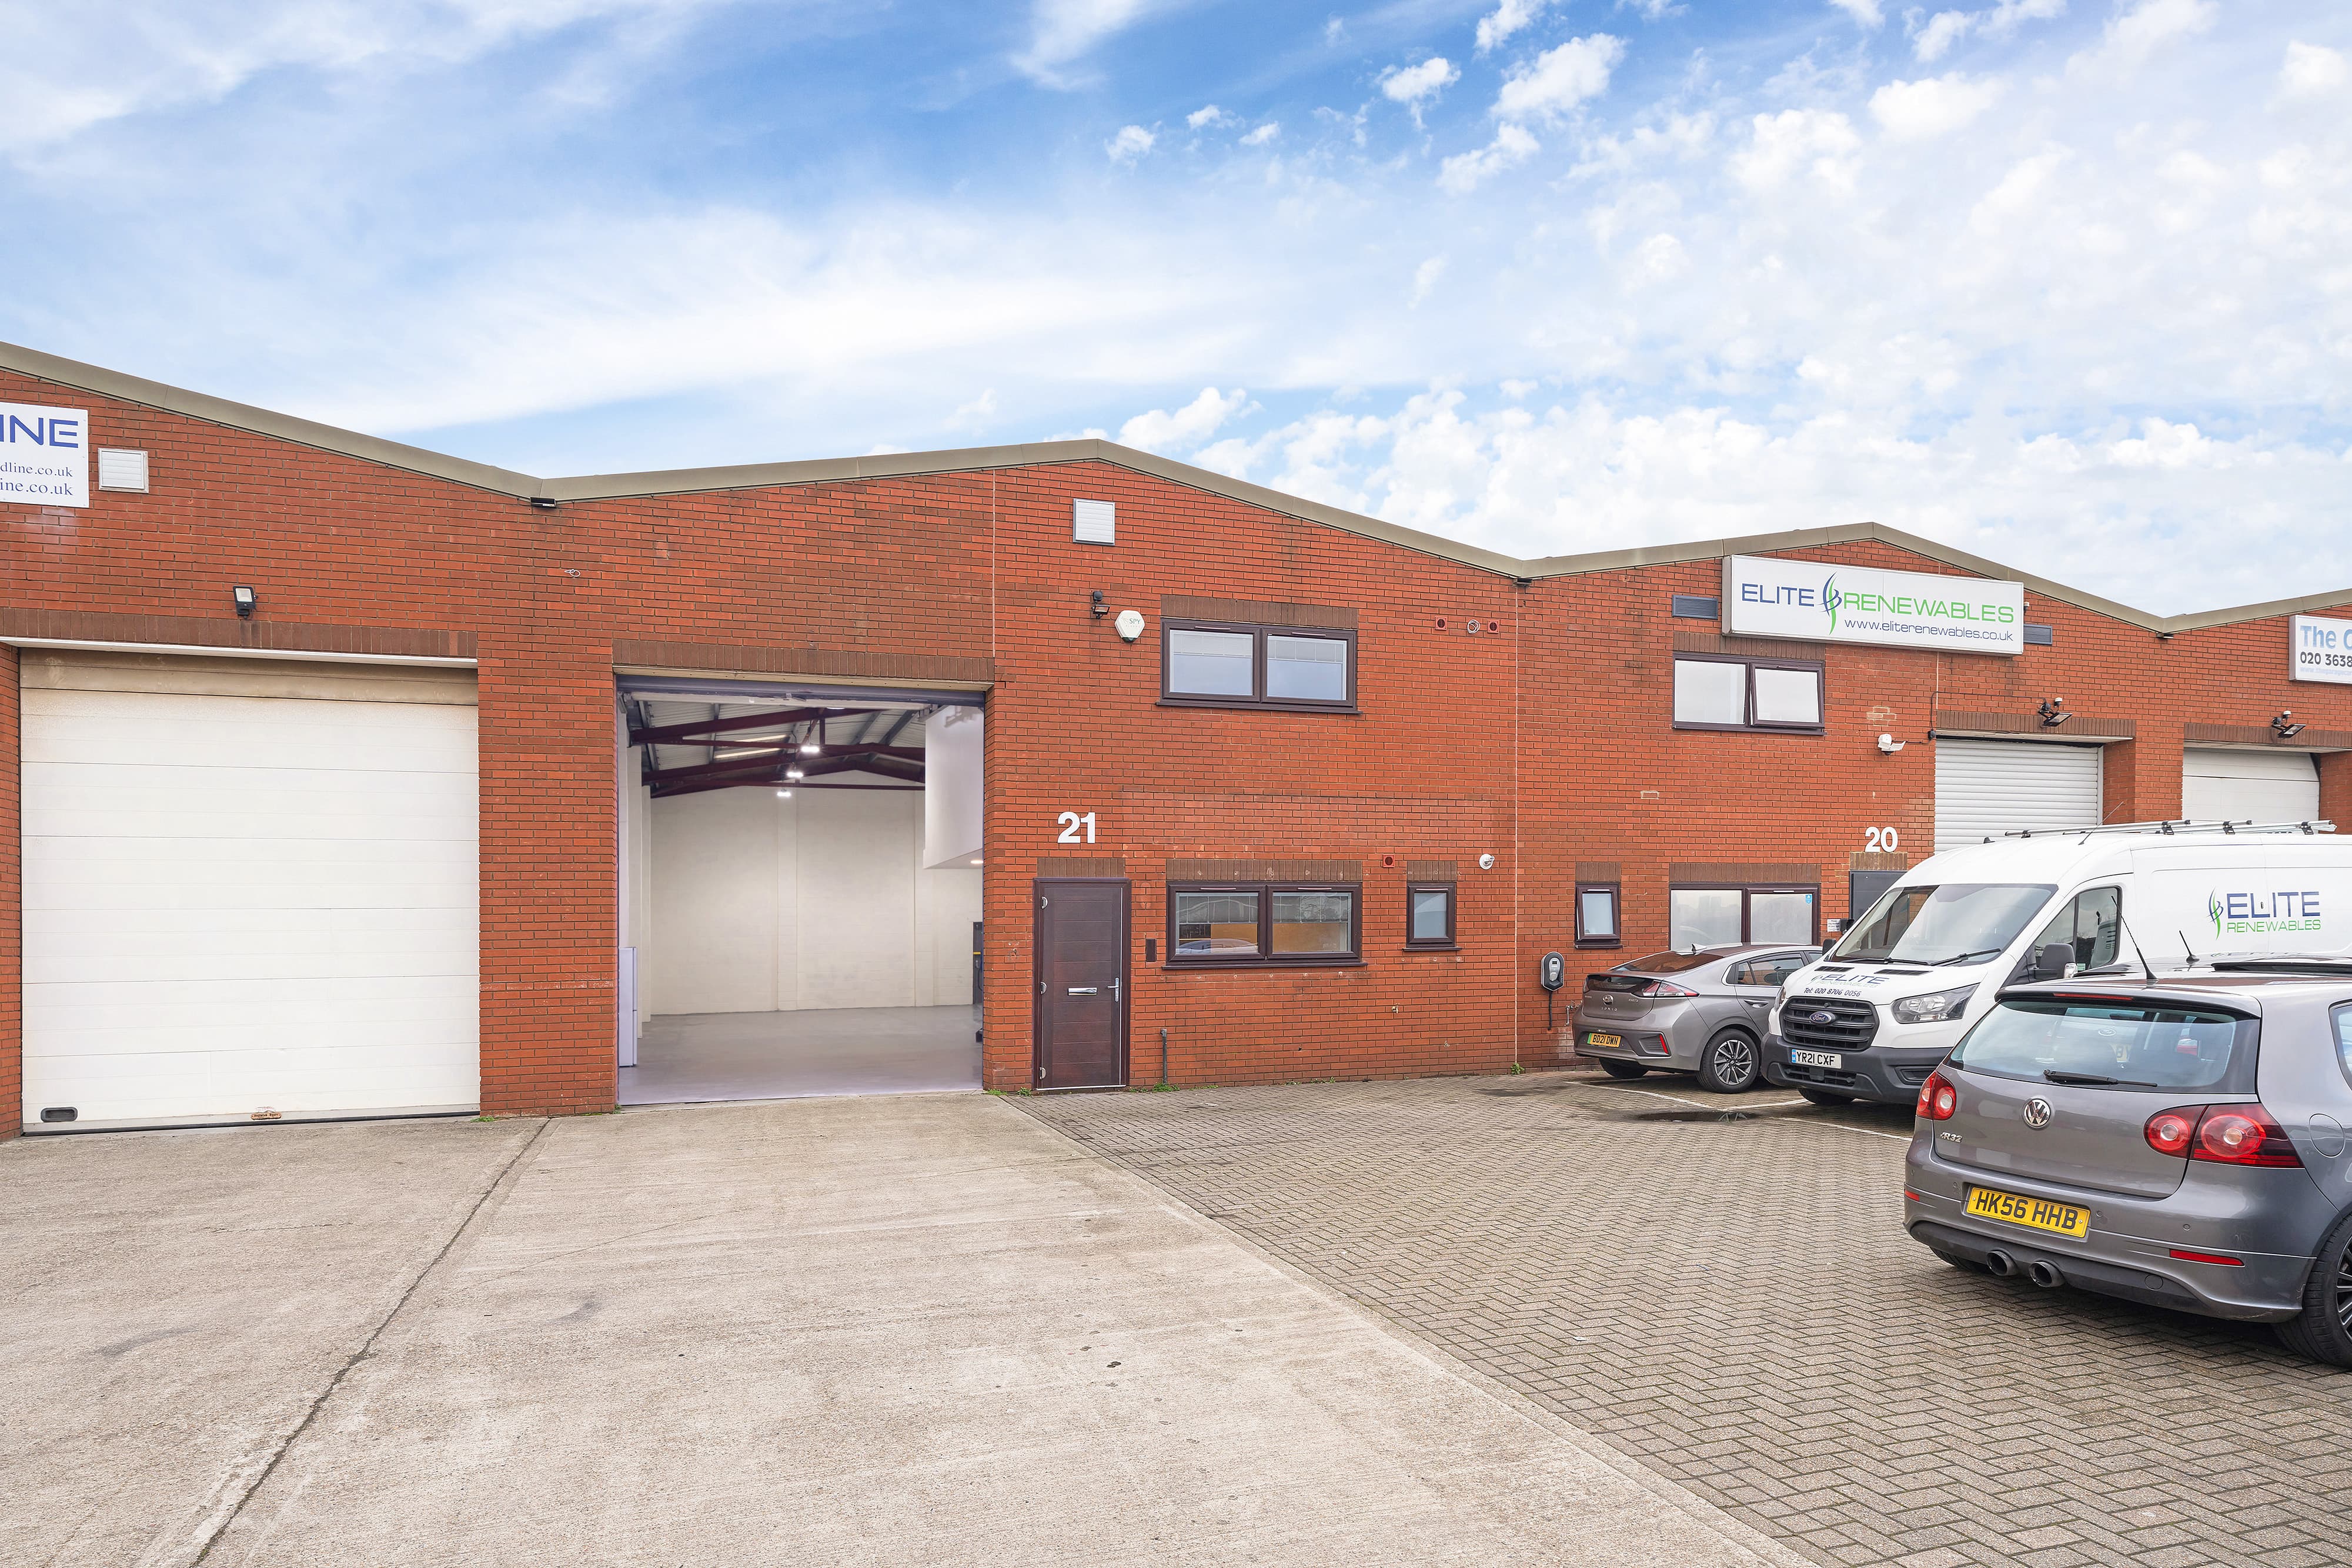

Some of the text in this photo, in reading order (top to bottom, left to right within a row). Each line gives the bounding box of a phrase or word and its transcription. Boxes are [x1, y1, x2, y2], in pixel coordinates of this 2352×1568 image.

[1742, 583, 2014, 623] ELITE RENEWABLES
[1845, 618, 2013, 641] www.eliterenewables.co.uk
[2300, 625, 2337, 649] The
[2300, 651, 2352, 667] 020 3638
[1057, 811, 1095, 843] 21
[1865, 827, 1898, 852] 20
[2226, 891, 2321, 919] ELITE
[2227, 920, 2321, 933] RENEWABLES
[1821, 974, 1890, 984] ELITE
[1592, 1035, 1606, 1044] BD21
[1796, 1051, 1835, 1065] YR21 CXF
[1975, 1191, 2079, 1230] HK56 HHB
